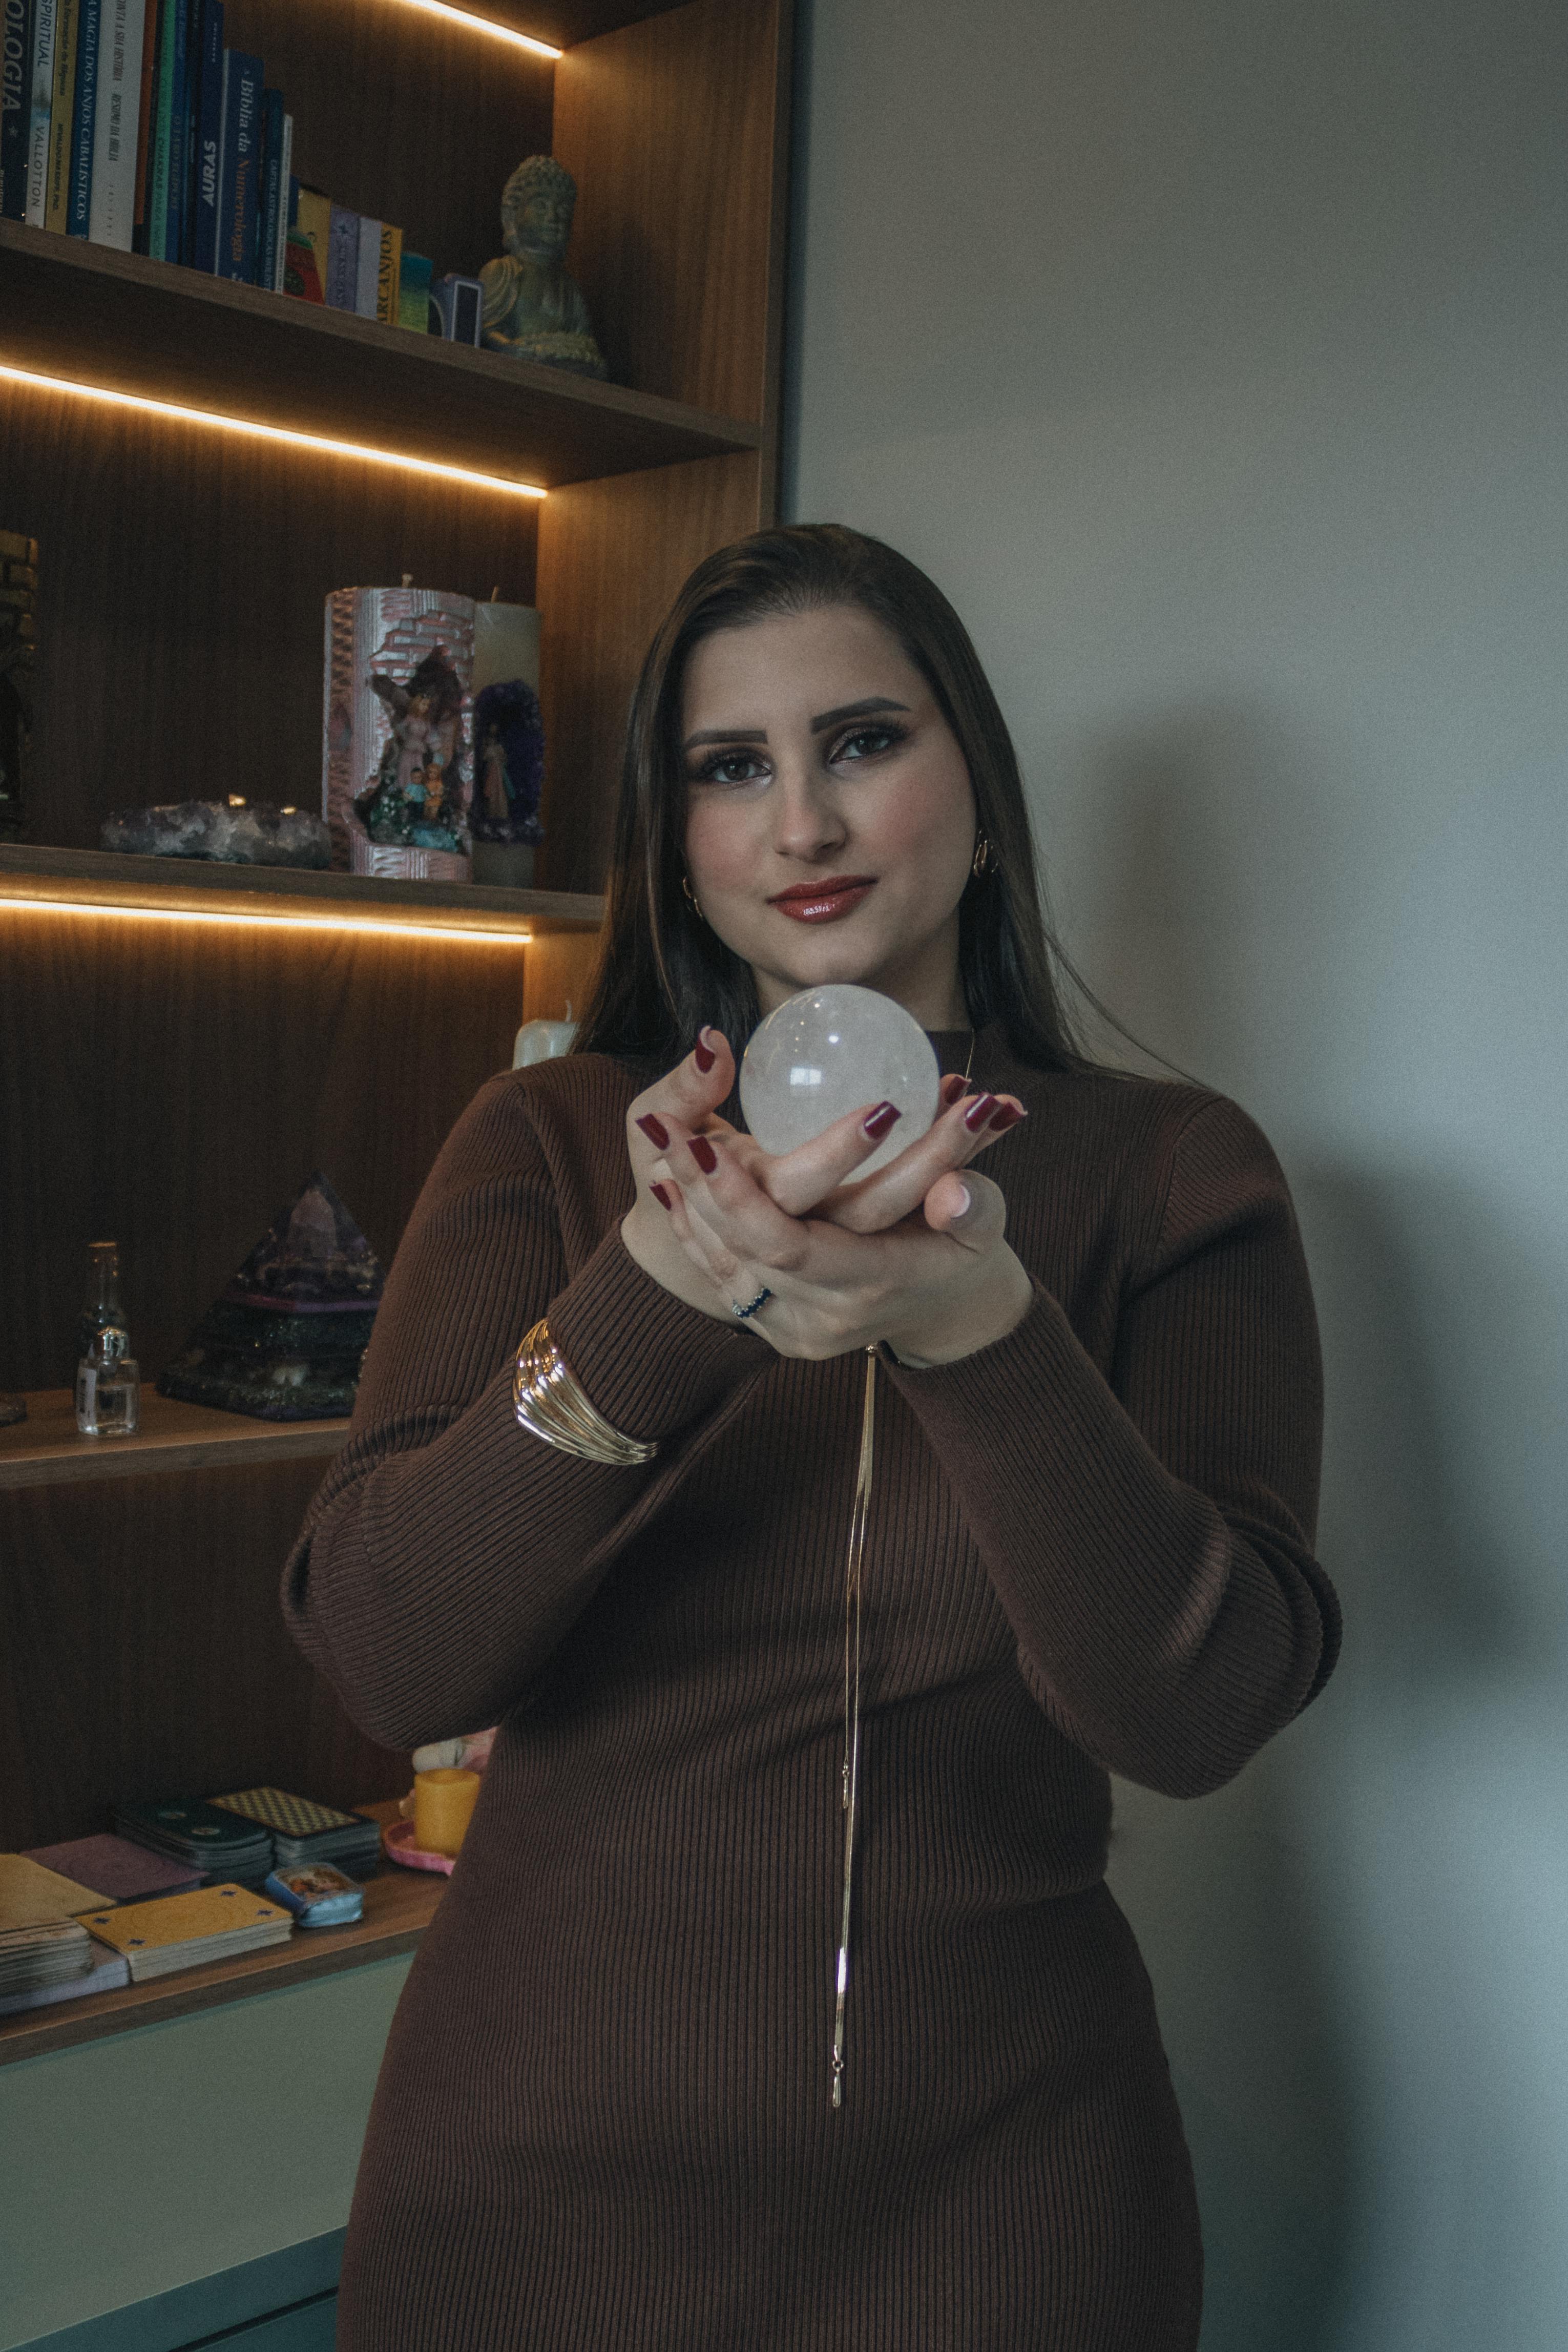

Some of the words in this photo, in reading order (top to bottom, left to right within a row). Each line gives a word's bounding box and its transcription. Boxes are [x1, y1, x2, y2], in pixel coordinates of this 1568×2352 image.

[86, 9, 97, 51] MAGIA
[83, 55, 95, 82] DOS
[80, 87, 93, 124] ANJOS
[111, 93, 122, 124] RESUMO
[239, 79, 254, 128] Bíblia
[237, 132, 251, 153] da
[32, 126, 46, 208] VALLOTTON
[76, 128, 90, 221] CABALÍSTICOS
[202, 140, 217, 207] AURAS
[268, 159, 278, 190] CARTAS
[231, 157, 249, 262] Numerologia
